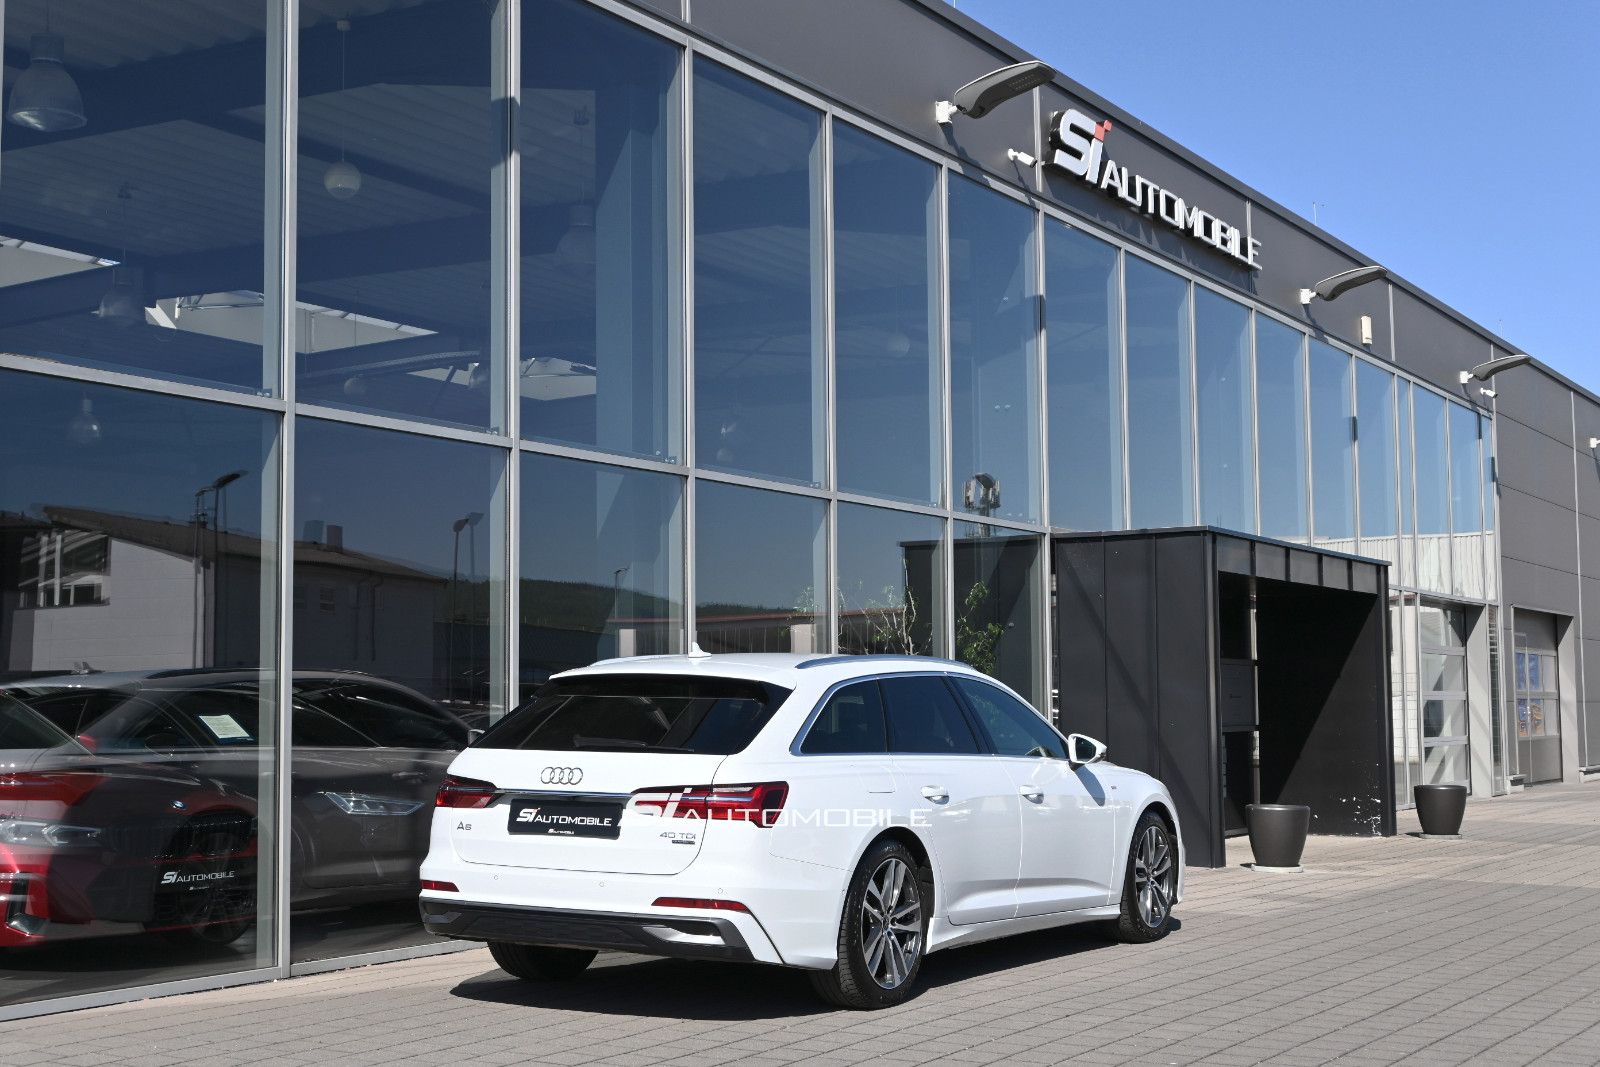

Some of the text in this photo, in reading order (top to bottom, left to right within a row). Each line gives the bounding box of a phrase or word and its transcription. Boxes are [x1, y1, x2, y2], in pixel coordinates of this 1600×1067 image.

[1100, 159, 1263, 271] AUTOMOBILE
[534, 814, 613, 827] AUTOMOBILE
[176, 870, 235, 883] AUTOMOBILE
